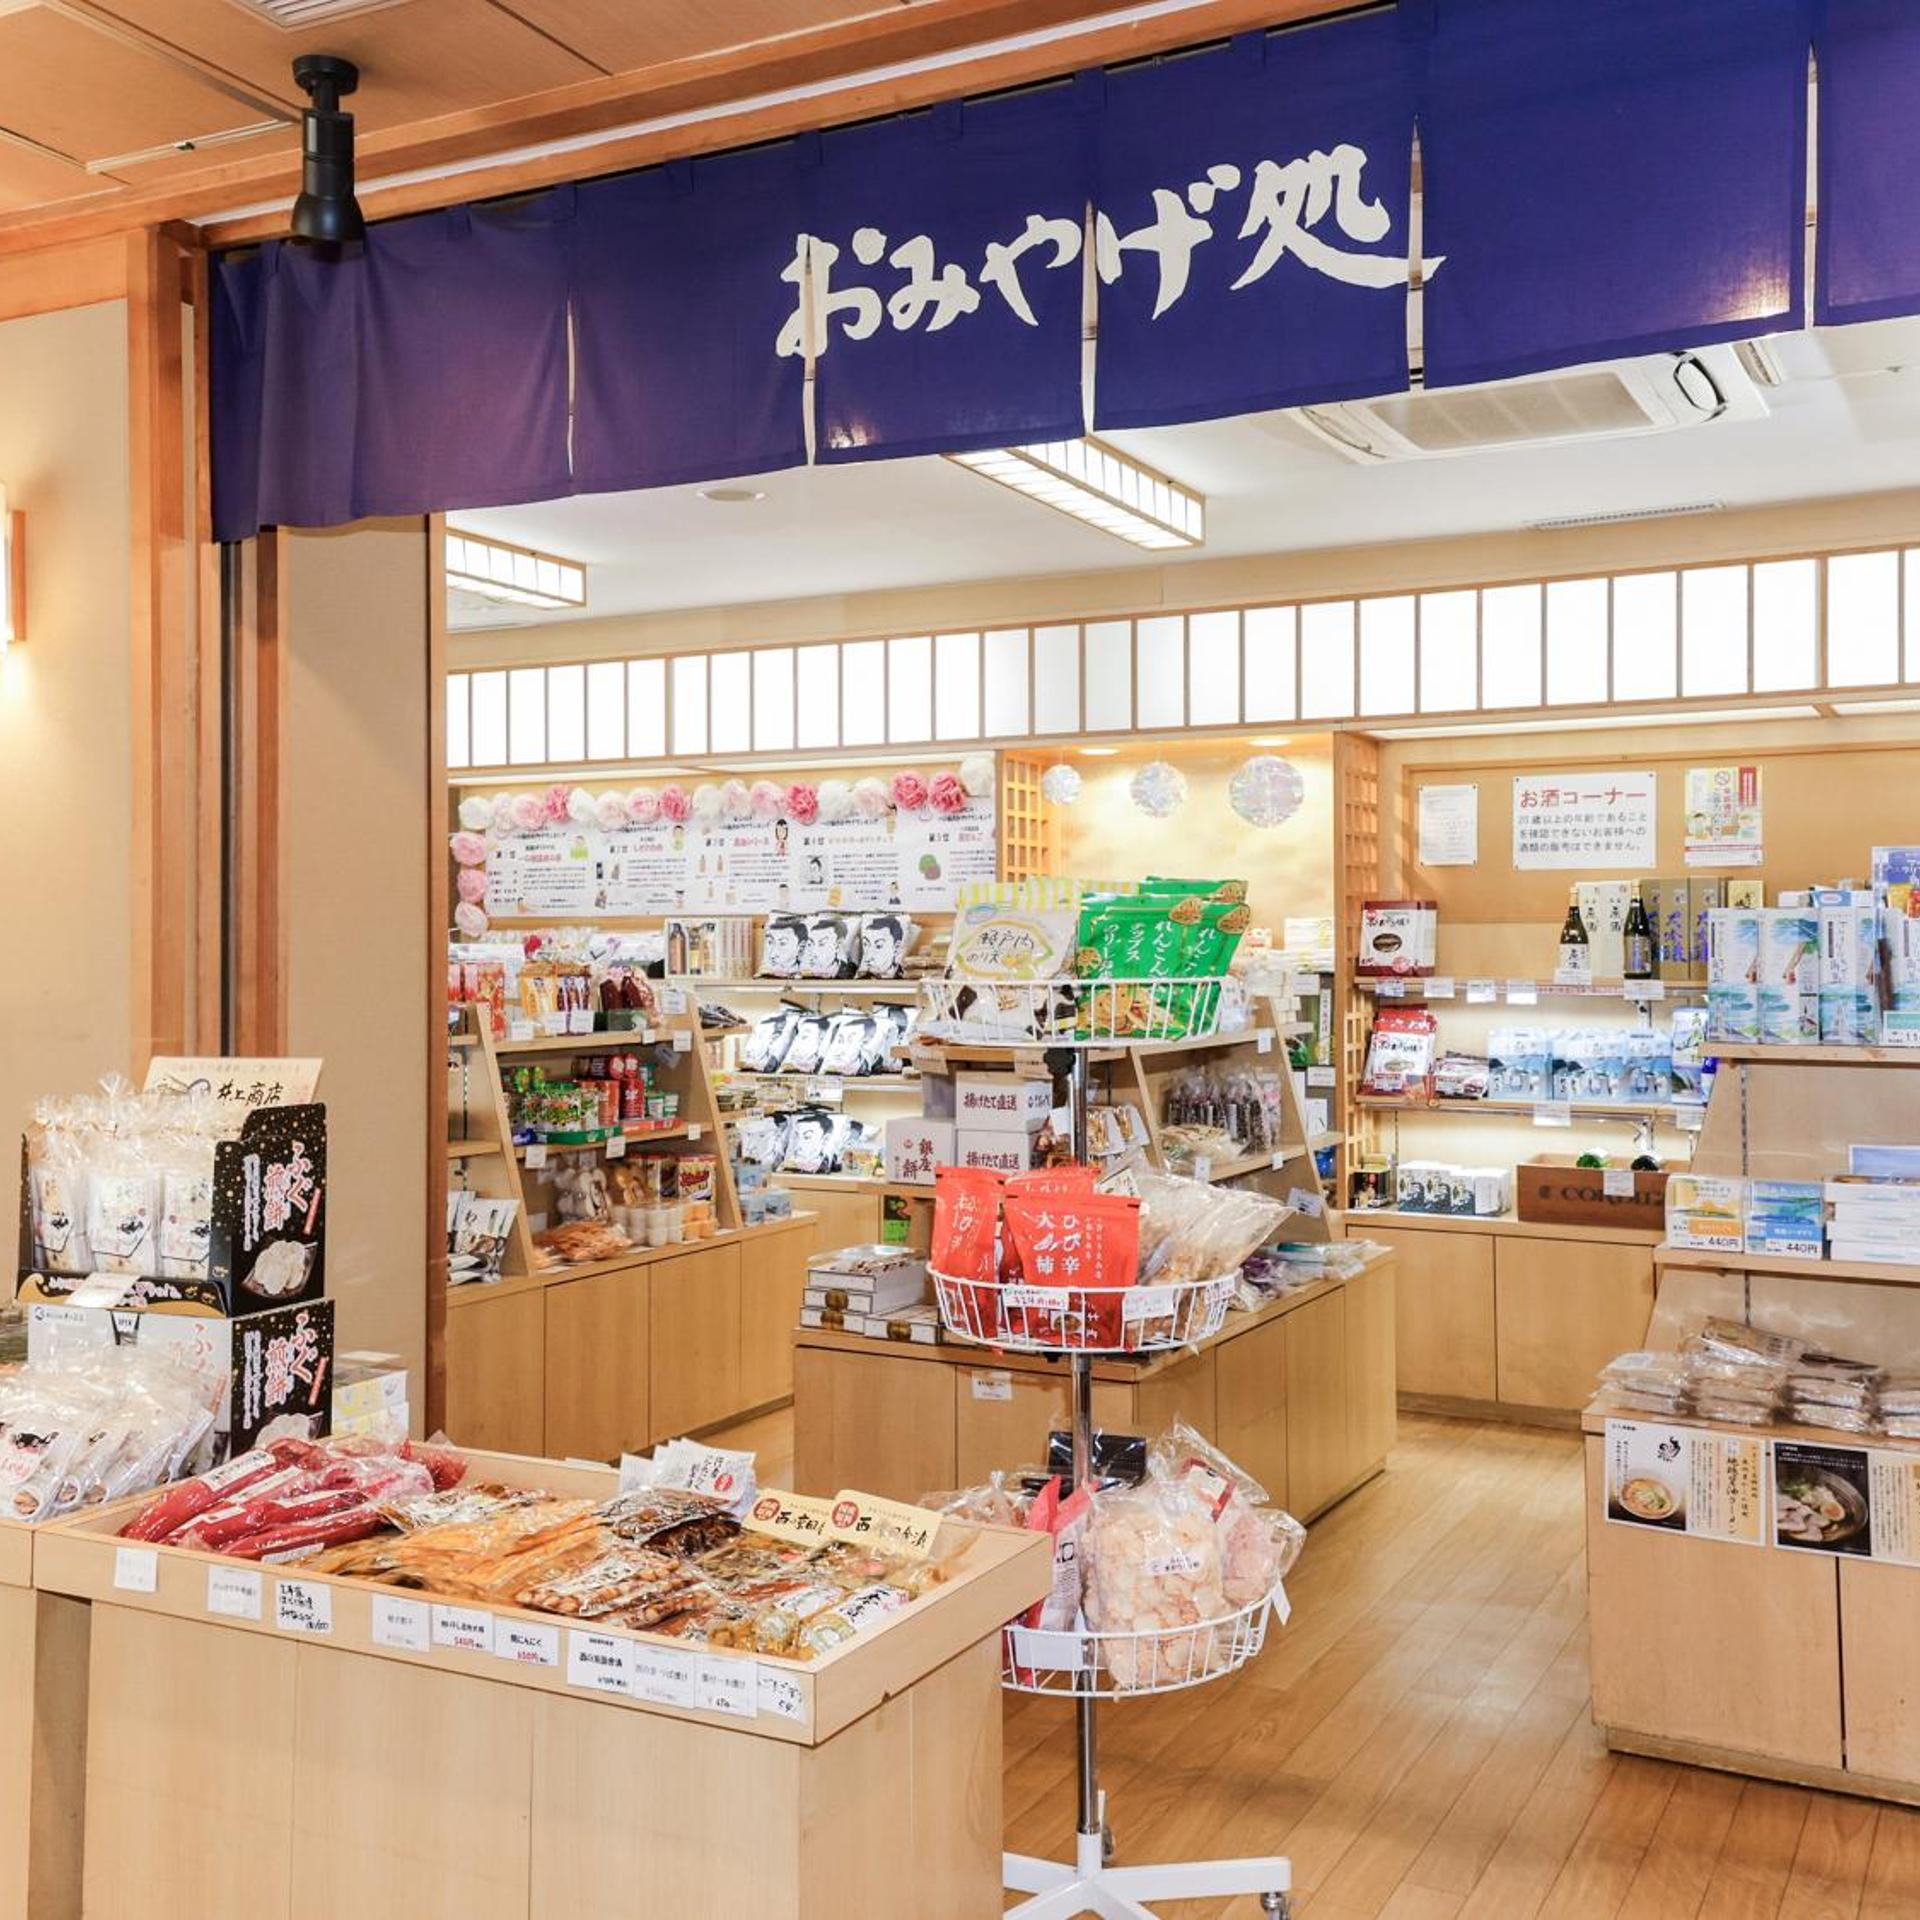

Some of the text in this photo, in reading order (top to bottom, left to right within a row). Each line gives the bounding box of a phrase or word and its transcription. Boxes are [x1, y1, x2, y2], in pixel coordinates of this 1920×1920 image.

[776, 144, 1446, 357] おみやげ処
[1520, 786, 1647, 808] お酒コーナー
[978, 928, 1035, 951] 瀬戸内
[1149, 920, 1174, 977] れんこん
[216, 1078, 284, 1107] 井上商店
[1707, 1236, 1739, 1248] 440円
[1785, 1243, 1819, 1255] 440円
